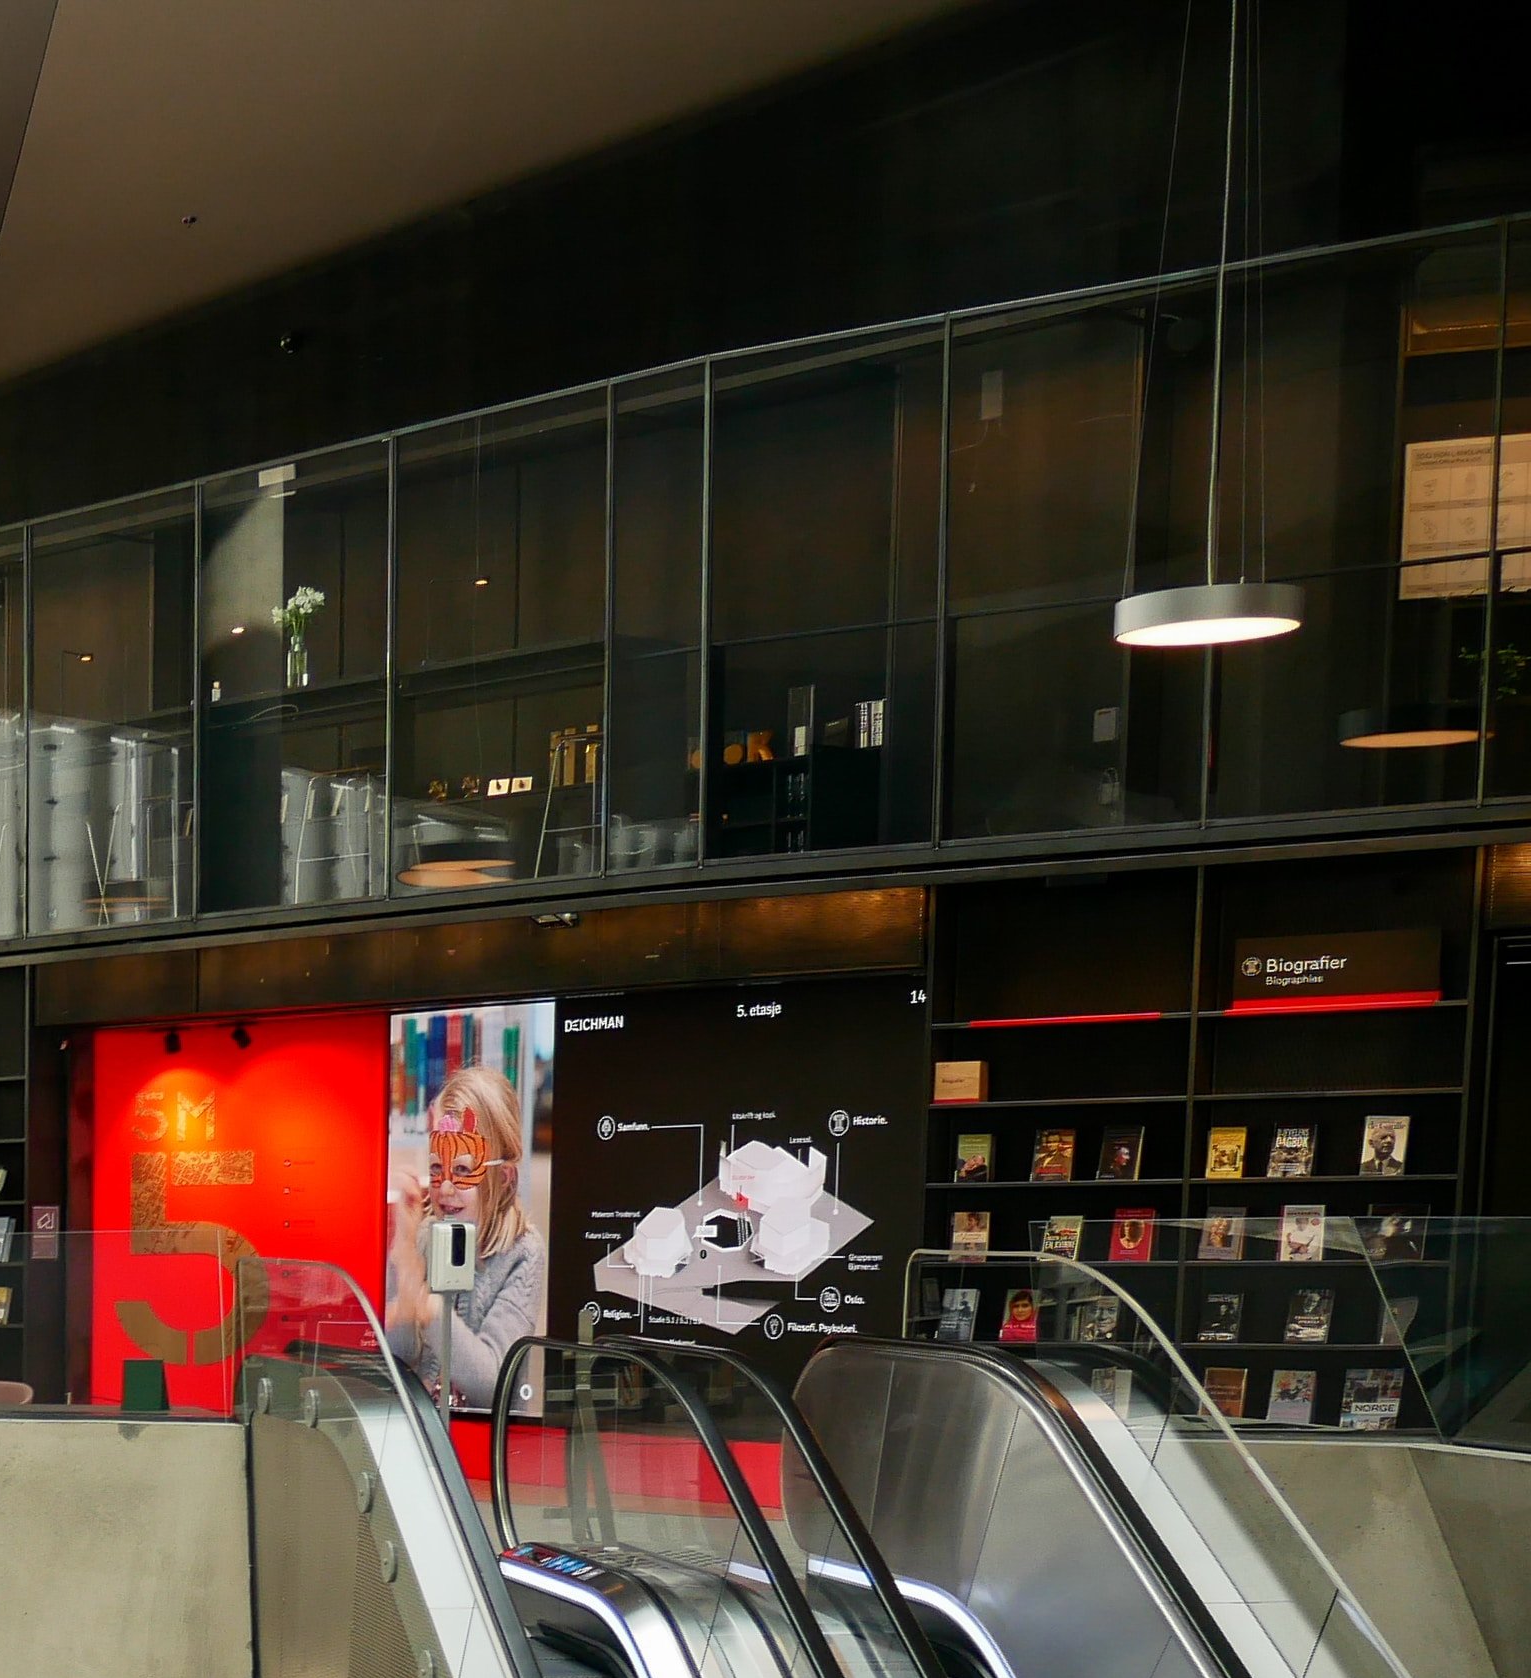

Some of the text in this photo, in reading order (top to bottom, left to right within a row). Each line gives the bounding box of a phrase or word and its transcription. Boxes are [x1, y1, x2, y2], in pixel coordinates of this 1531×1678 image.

[1266, 955, 1347, 974] Biografier
[1265, 974, 1324, 986] Biographies
[736, 1002, 782, 1018] 5. etasje
[565, 1015, 624, 1033] DEICHMAN
[852, 1114, 888, 1126] Historie.
[844, 1294, 866, 1304] Oslo.
[603, 1309, 633, 1320] Religion.
[1355, 1403, 1396, 1412] NORGE
